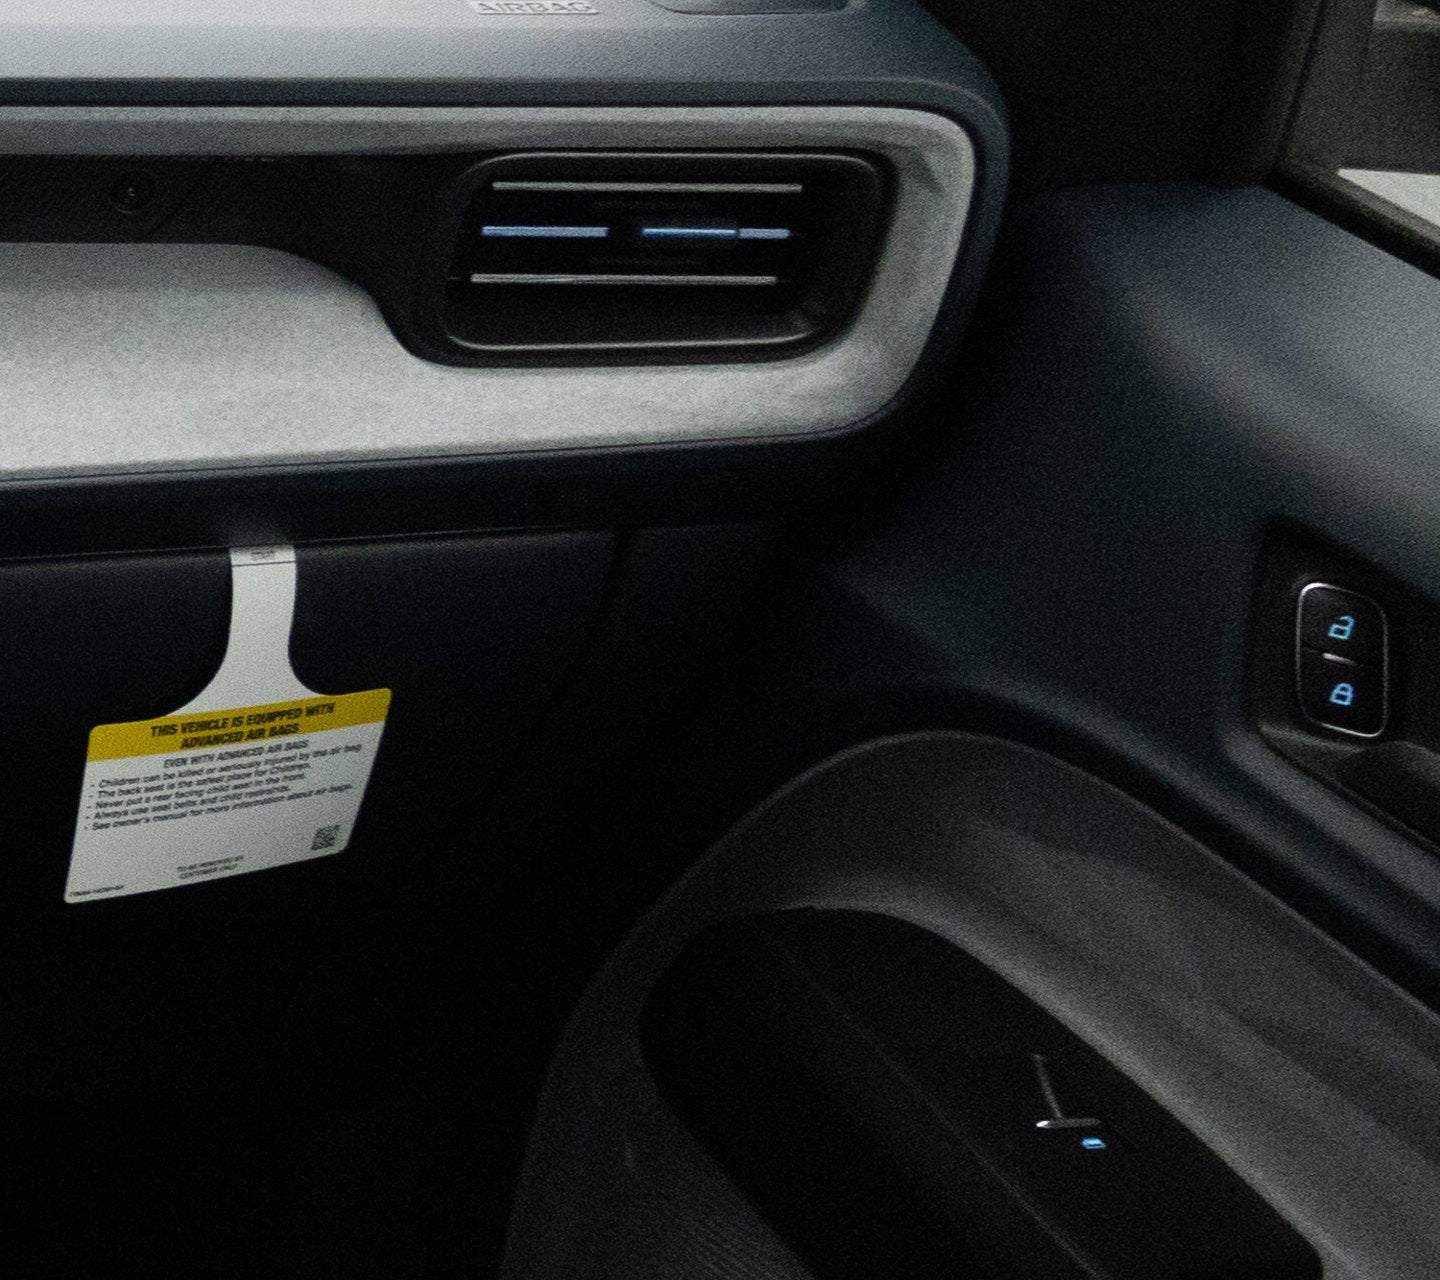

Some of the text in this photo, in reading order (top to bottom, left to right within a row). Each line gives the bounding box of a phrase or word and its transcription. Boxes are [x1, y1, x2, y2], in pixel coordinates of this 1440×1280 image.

[477, 1, 593, 13] AIRBAG
[150, 702, 336, 737] THIS VEHICLE IS EQUIPPED WITH
[181, 722, 300, 749] ADVANCED AIR BAGS
[163, 757, 188, 769] EVEN
[190, 753, 215, 765] WITH
[217, 746, 265, 761] ADVANCED
[267, 743, 282, 754] AIR
[99, 777, 140, 788] Children
